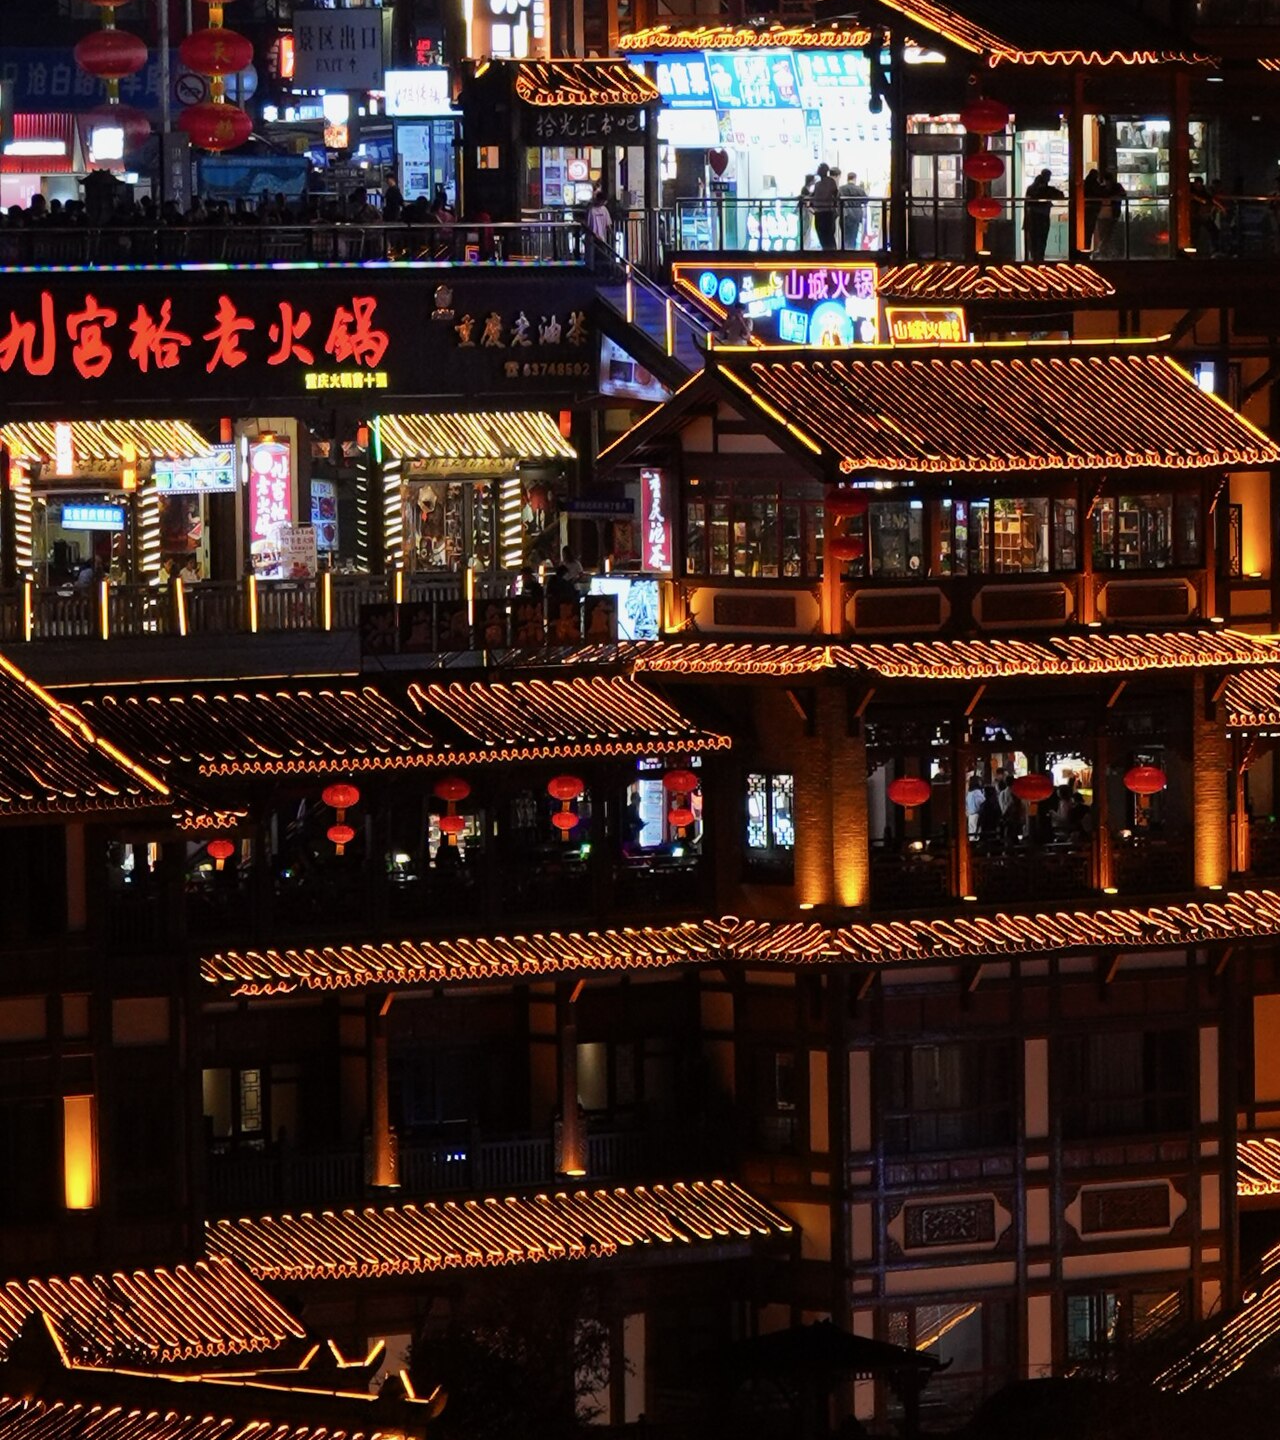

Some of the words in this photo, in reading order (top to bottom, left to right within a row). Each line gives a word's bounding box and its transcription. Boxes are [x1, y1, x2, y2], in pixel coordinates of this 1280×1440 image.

[299, 25, 376, 51] 景区出口
[785, 269, 874, 300] 山城火锅
